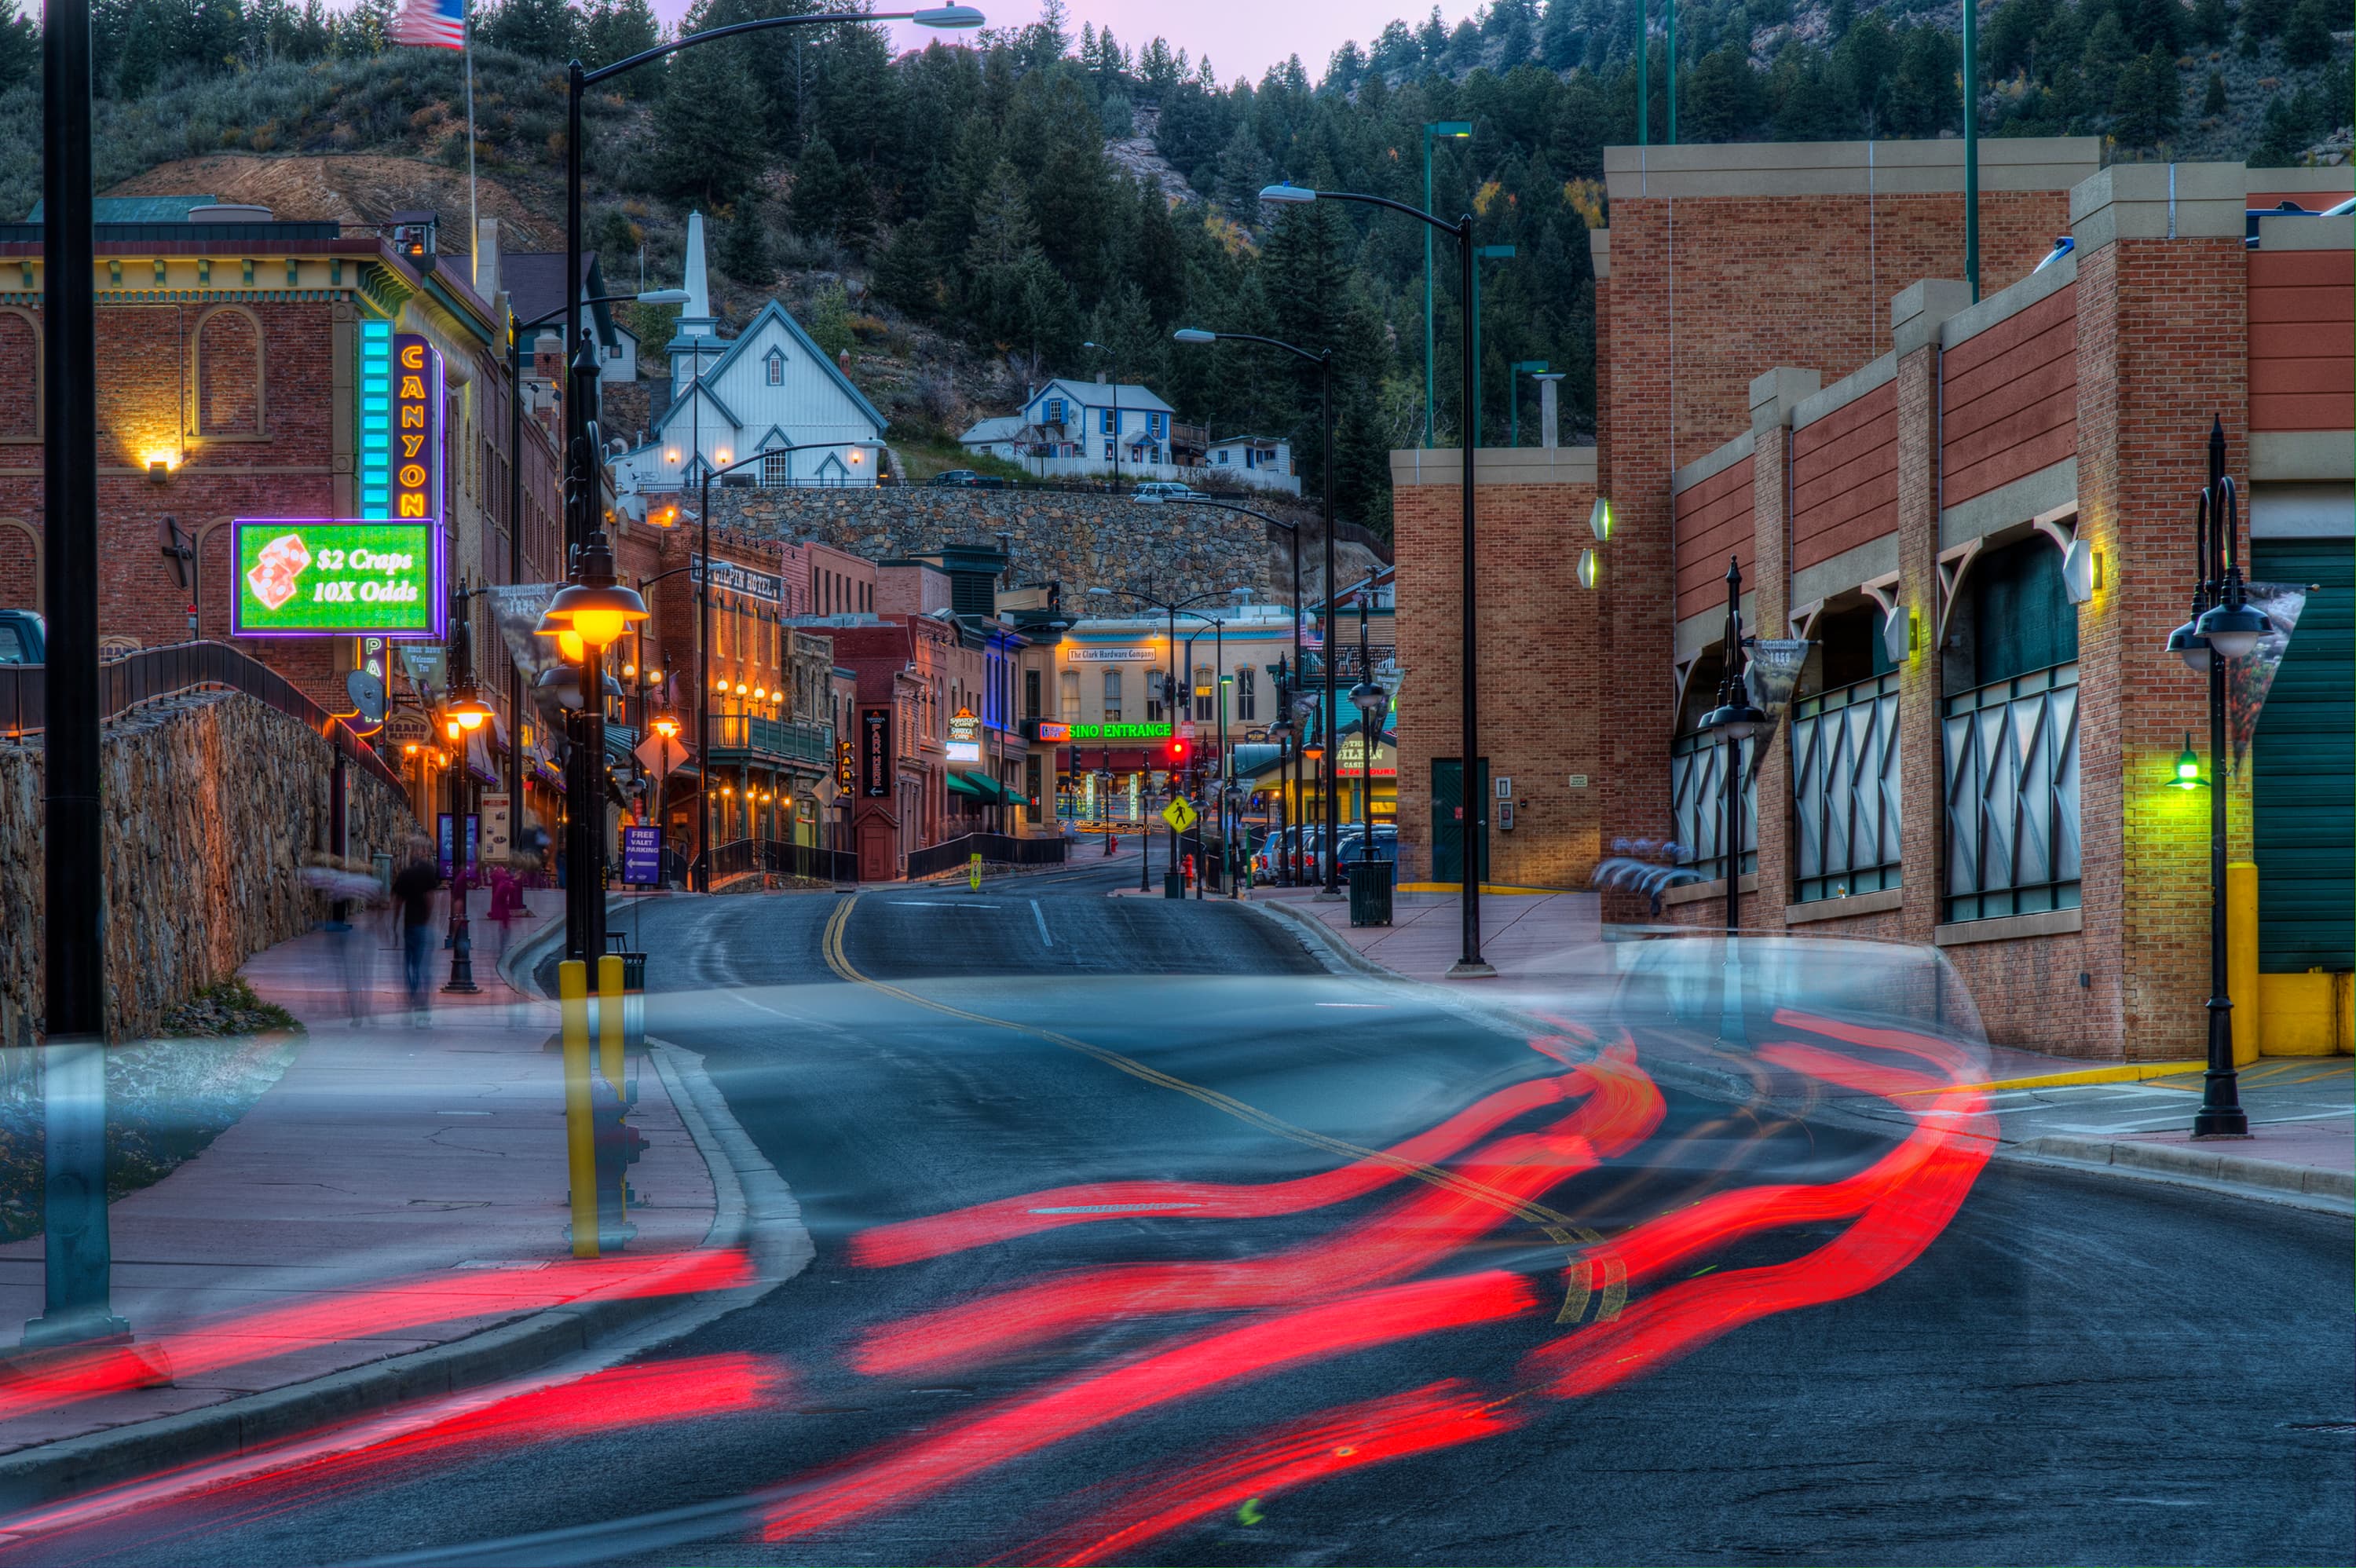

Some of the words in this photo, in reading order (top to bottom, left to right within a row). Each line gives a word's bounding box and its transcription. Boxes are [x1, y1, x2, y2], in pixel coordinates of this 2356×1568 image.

[400, 345, 426, 517] CANYON
[316, 549, 345, 571] $2
[349, 549, 413, 575] Craps
[313, 581, 357, 601] 10X
[360, 580, 418, 601] Odds
[713, 567, 744, 589] GILPIN
[747, 572, 773, 596] HOTEL
[1082, 650, 1098, 659] Clark
[1129, 650, 1154, 660] Company
[1762, 640, 1799, 649] Established
[387, 723, 427, 733] GRAND
[1070, 724, 1099, 737] SINO
[1103, 723, 1172, 736] ENTRANCE
[872, 723, 881, 755] PARK
[873, 756, 881, 787] HERE
[631, 831, 654, 839] FREE
